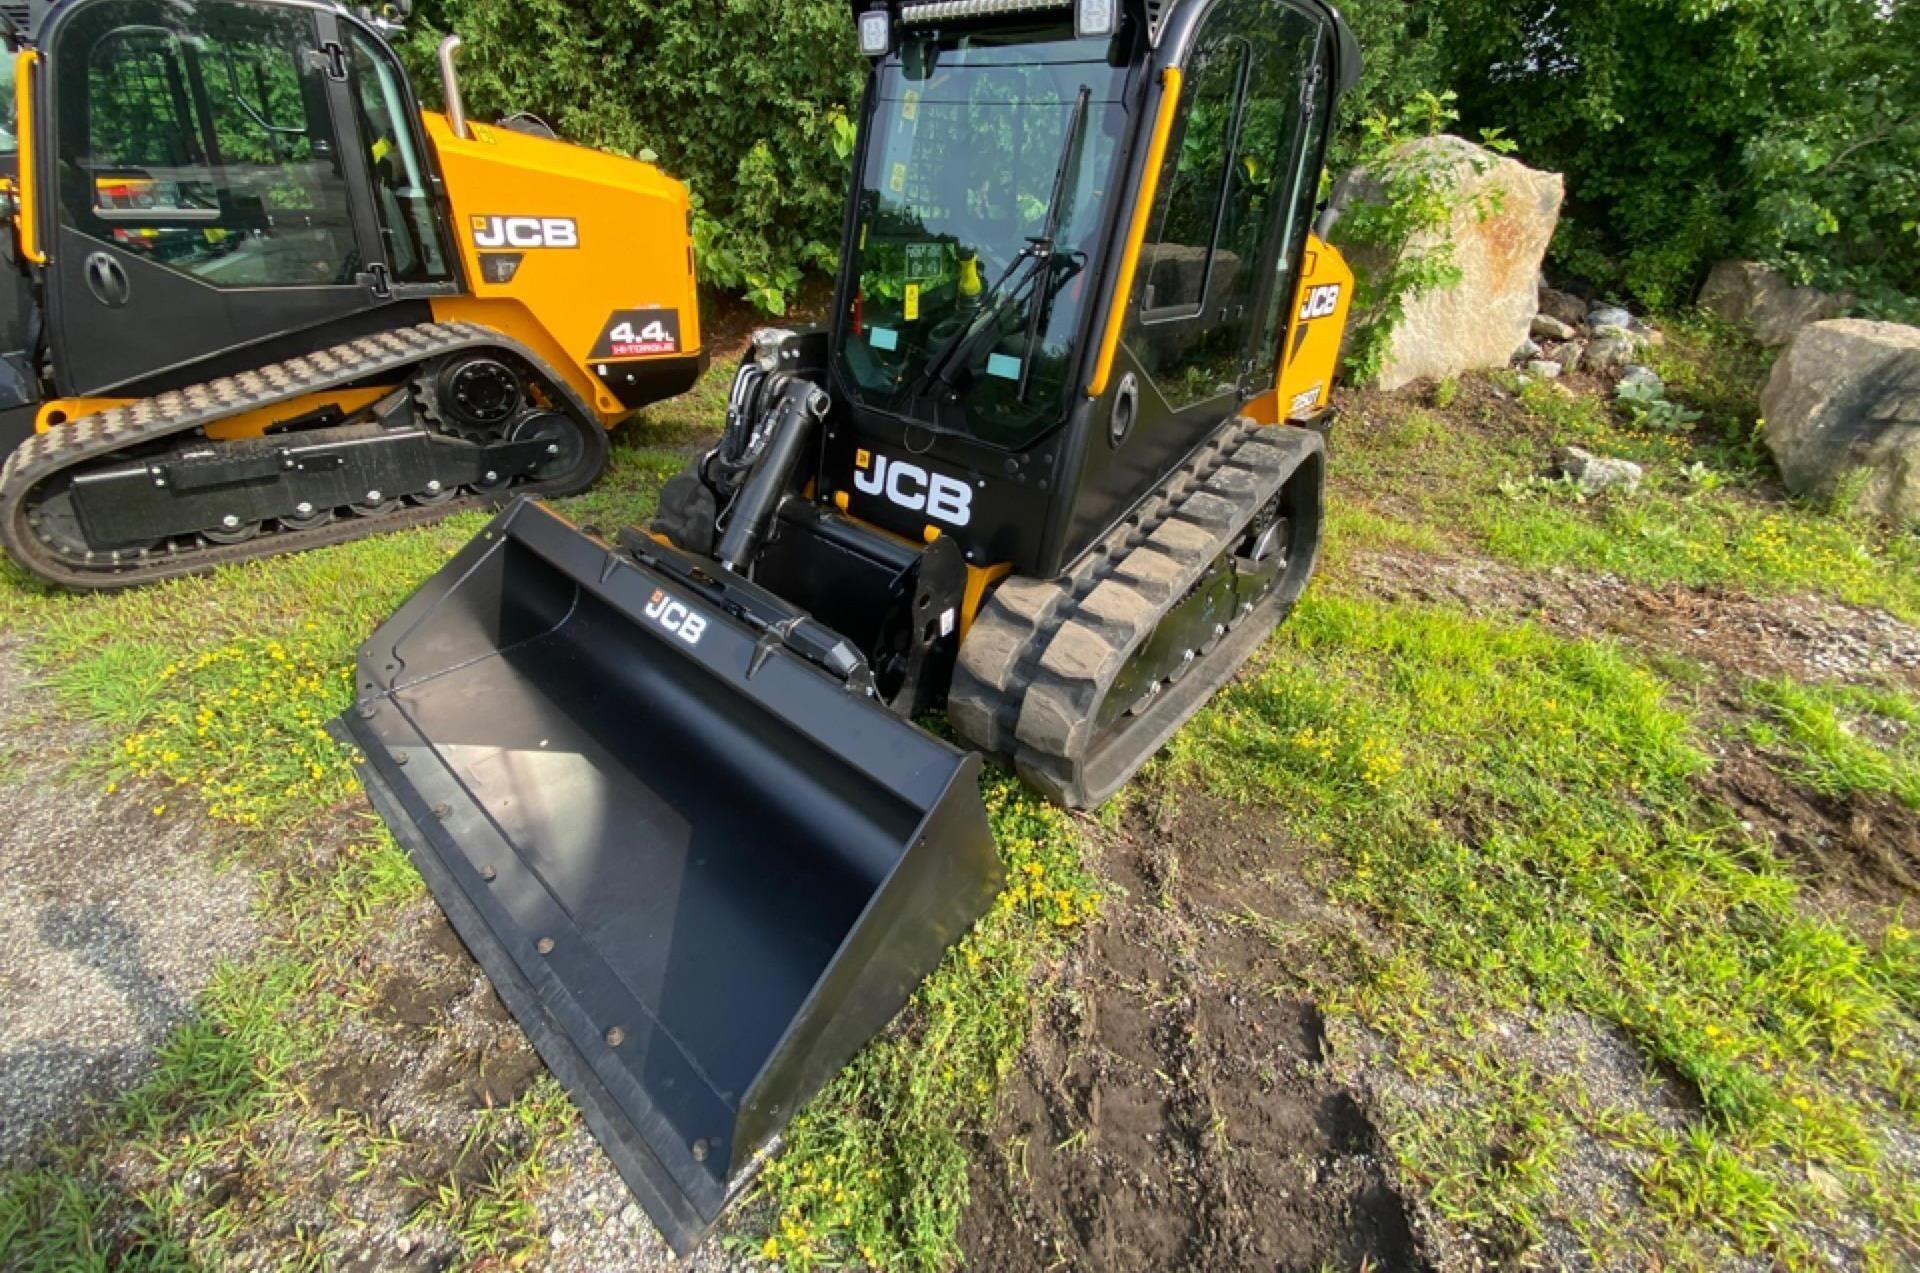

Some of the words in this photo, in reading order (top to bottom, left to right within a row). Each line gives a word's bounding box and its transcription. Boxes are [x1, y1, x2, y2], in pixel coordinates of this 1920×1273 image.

[472, 216, 577, 246] JCB
[1300, 285, 1340, 318] JCB
[853, 449, 973, 526] JCB
[646, 590, 706, 643] JCB
